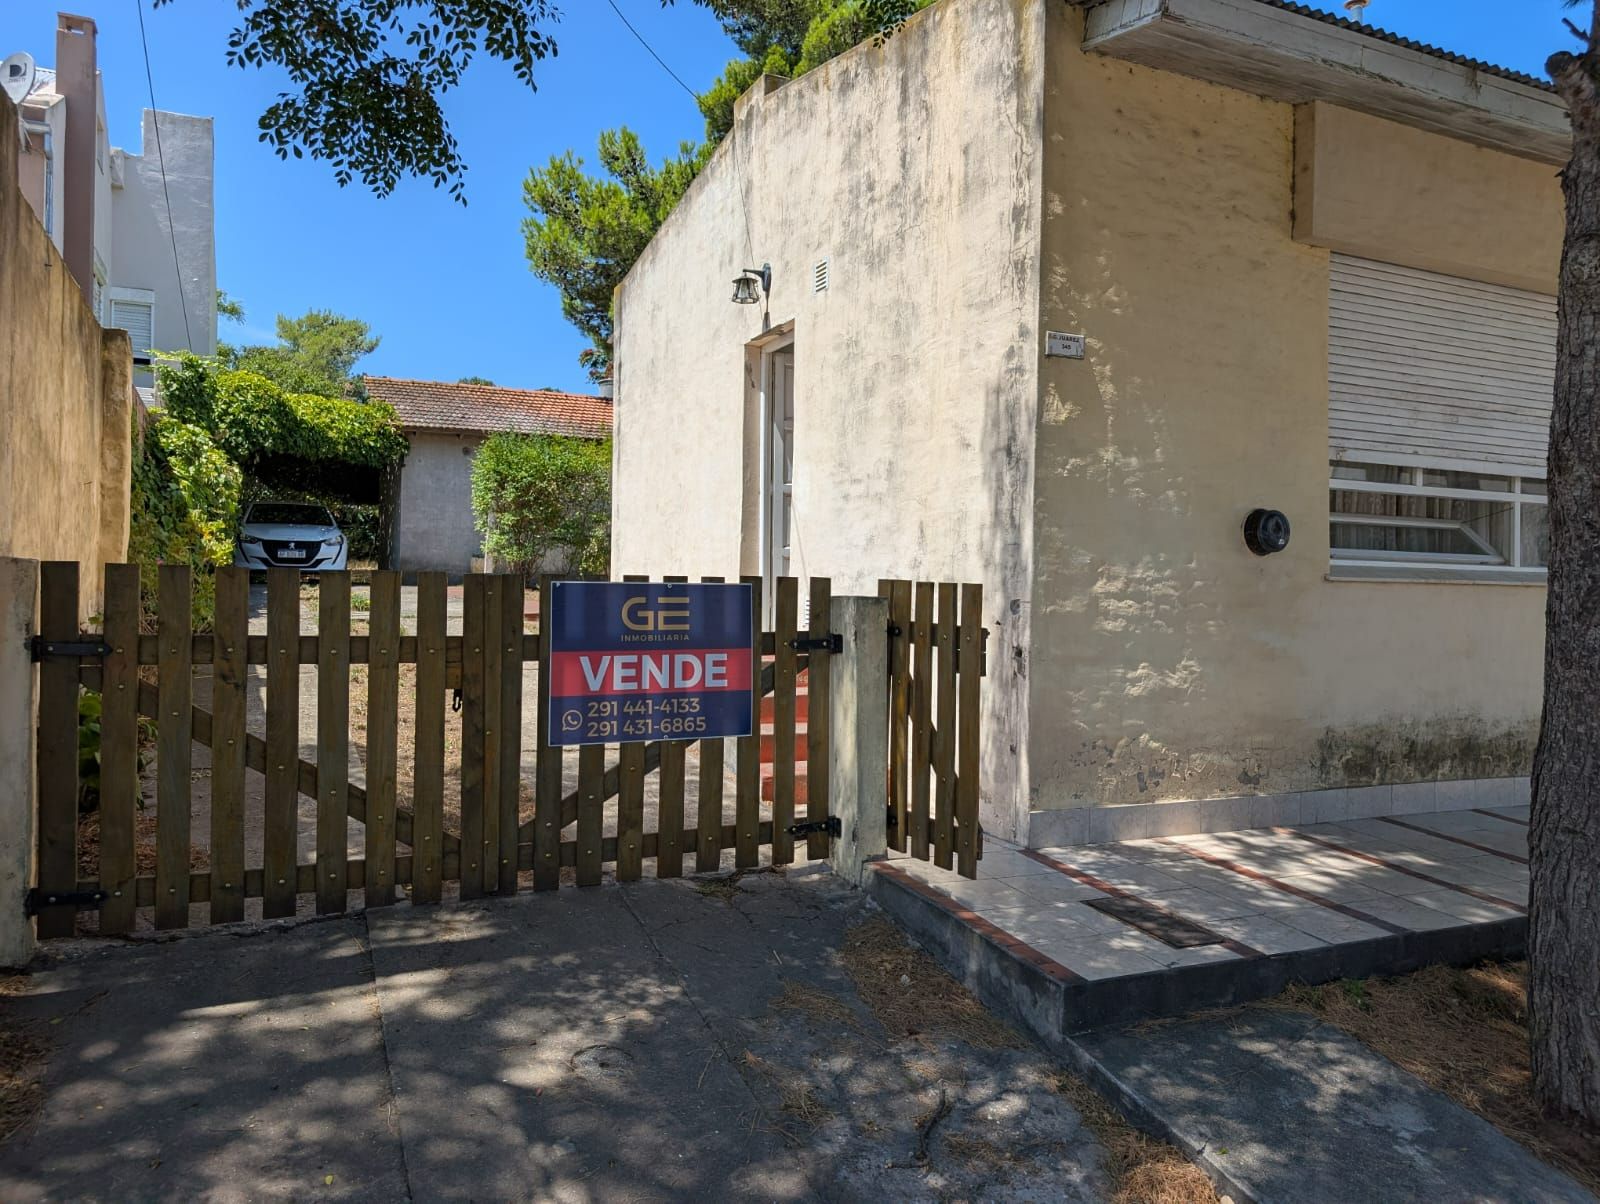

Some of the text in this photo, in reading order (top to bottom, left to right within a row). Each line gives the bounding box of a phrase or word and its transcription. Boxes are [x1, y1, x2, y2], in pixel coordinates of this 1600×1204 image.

[621, 596, 690, 631] GE
[620, 634, 690, 642] INMOBILIARIA
[579, 653, 728, 692] VENDE
[587, 698, 700, 718] 291 441-4133
[587, 717, 706, 737] 291 431-6865
